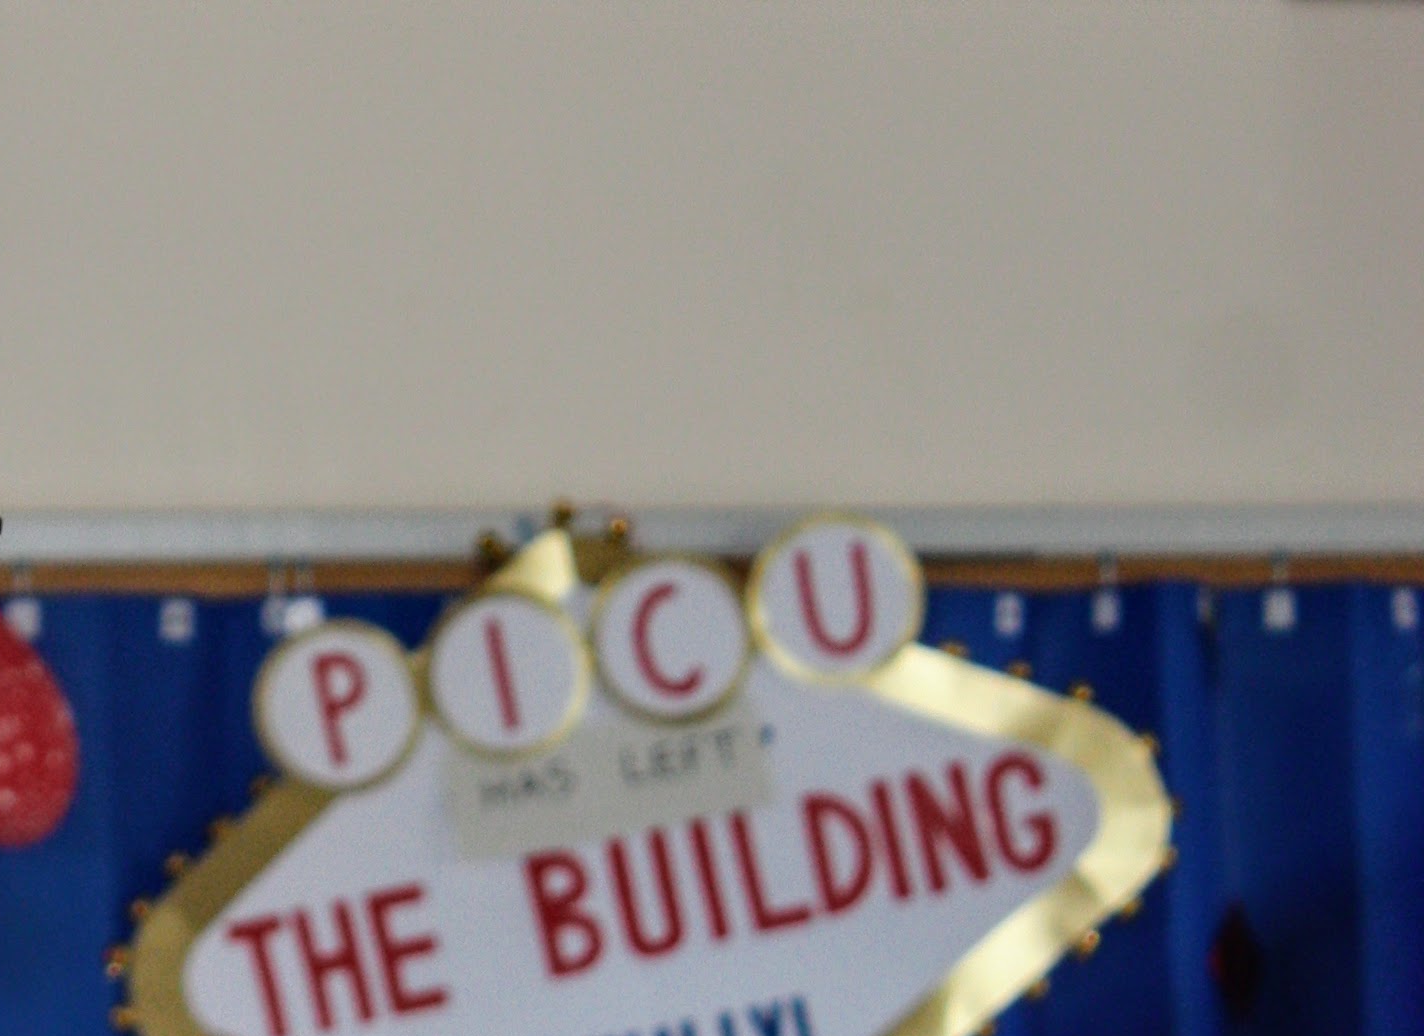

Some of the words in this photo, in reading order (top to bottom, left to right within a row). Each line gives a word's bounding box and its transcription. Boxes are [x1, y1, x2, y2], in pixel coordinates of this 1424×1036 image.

[478, 756, 578, 808] HAS
[618, 726, 738, 790] LEFT
[522, 751, 1058, 981] BUILDING
